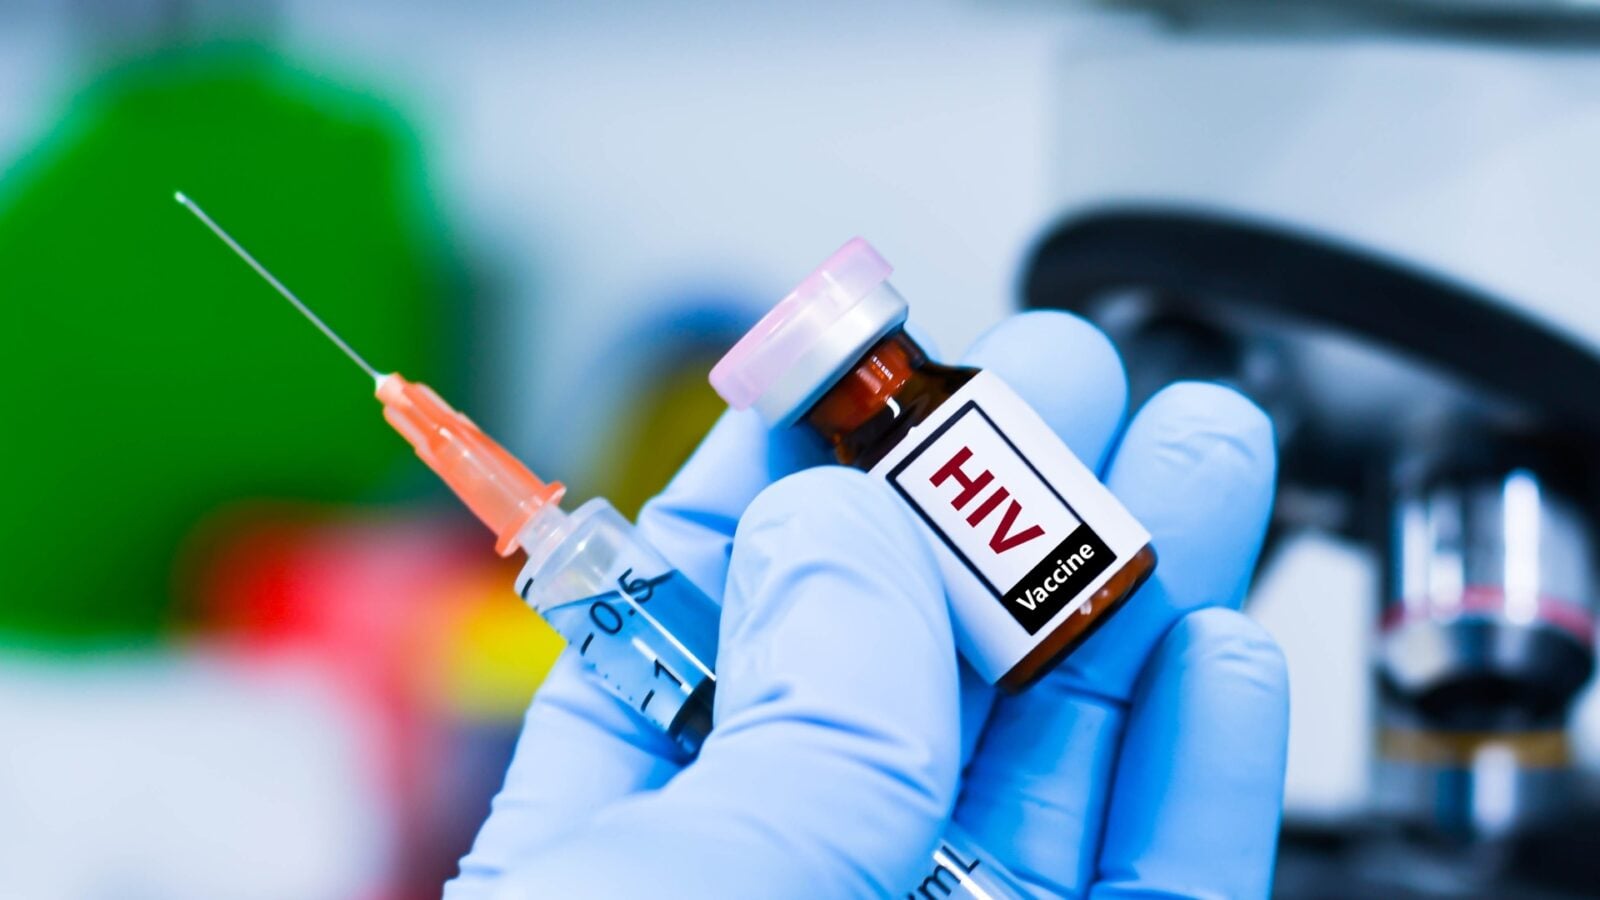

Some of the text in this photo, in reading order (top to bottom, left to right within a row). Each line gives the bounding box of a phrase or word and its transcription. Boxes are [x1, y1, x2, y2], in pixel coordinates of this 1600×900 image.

[929, 446, 1046, 555] HIV
[1015, 543, 1095, 611] Vaccine
[654, 658, 684, 687] 1
